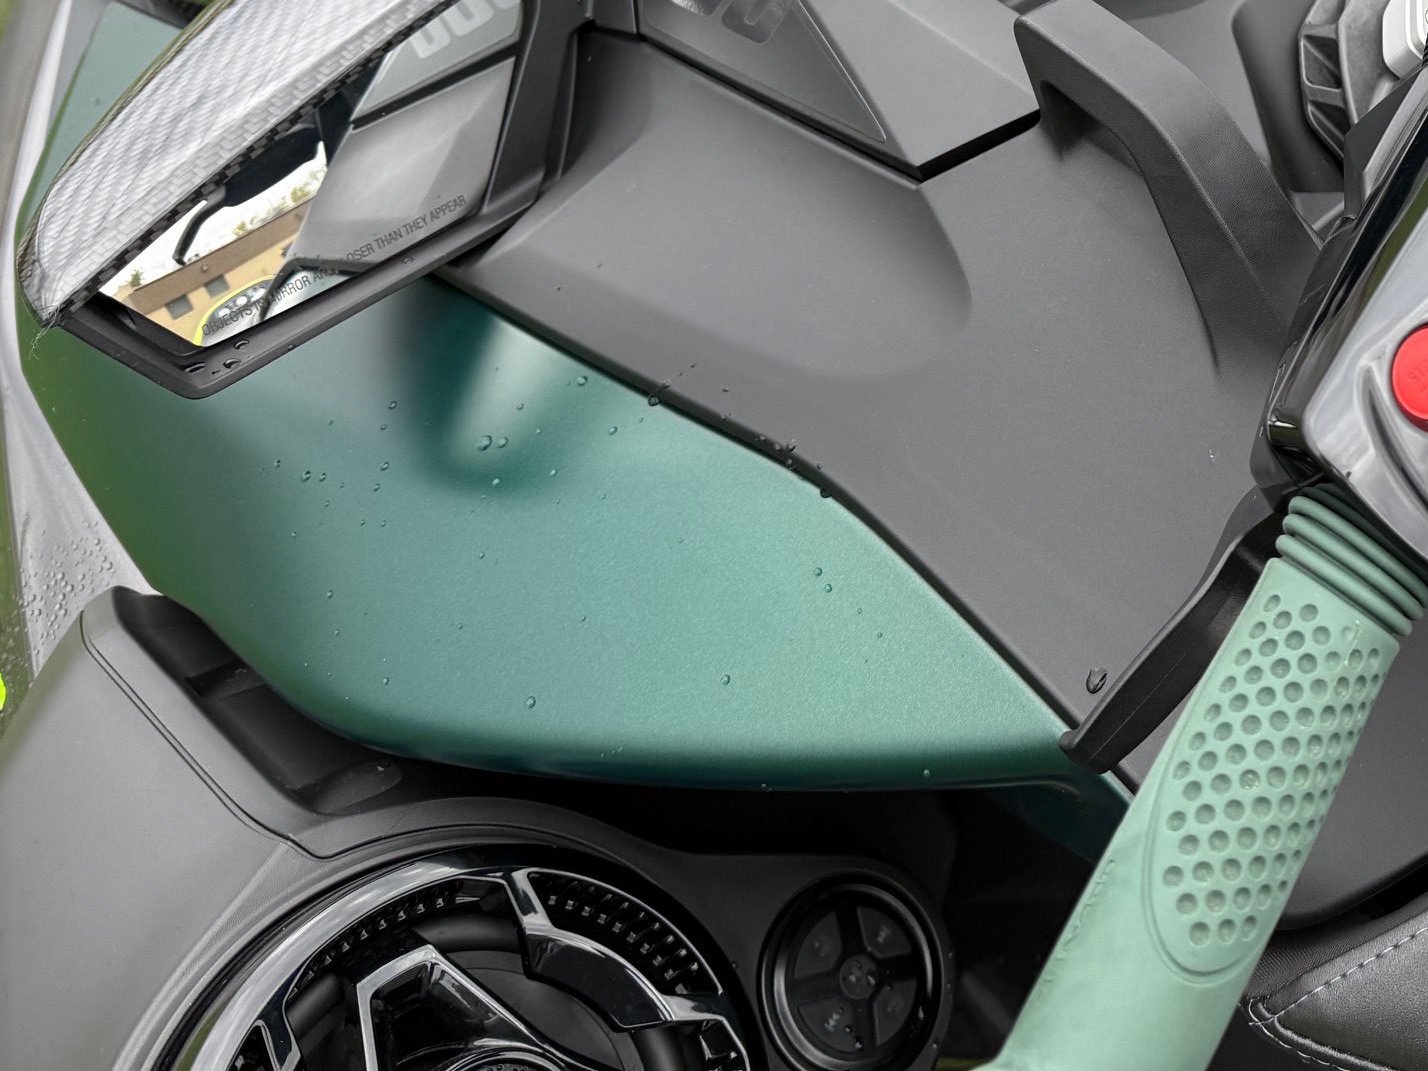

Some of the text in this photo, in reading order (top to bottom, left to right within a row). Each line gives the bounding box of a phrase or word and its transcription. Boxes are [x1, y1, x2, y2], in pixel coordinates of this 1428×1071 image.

[202, 303, 253, 336] OBJECTS
[374, 228, 404, 250] THAN
[403, 214, 427, 236] THEY
[430, 195, 467, 222] APPEAR
